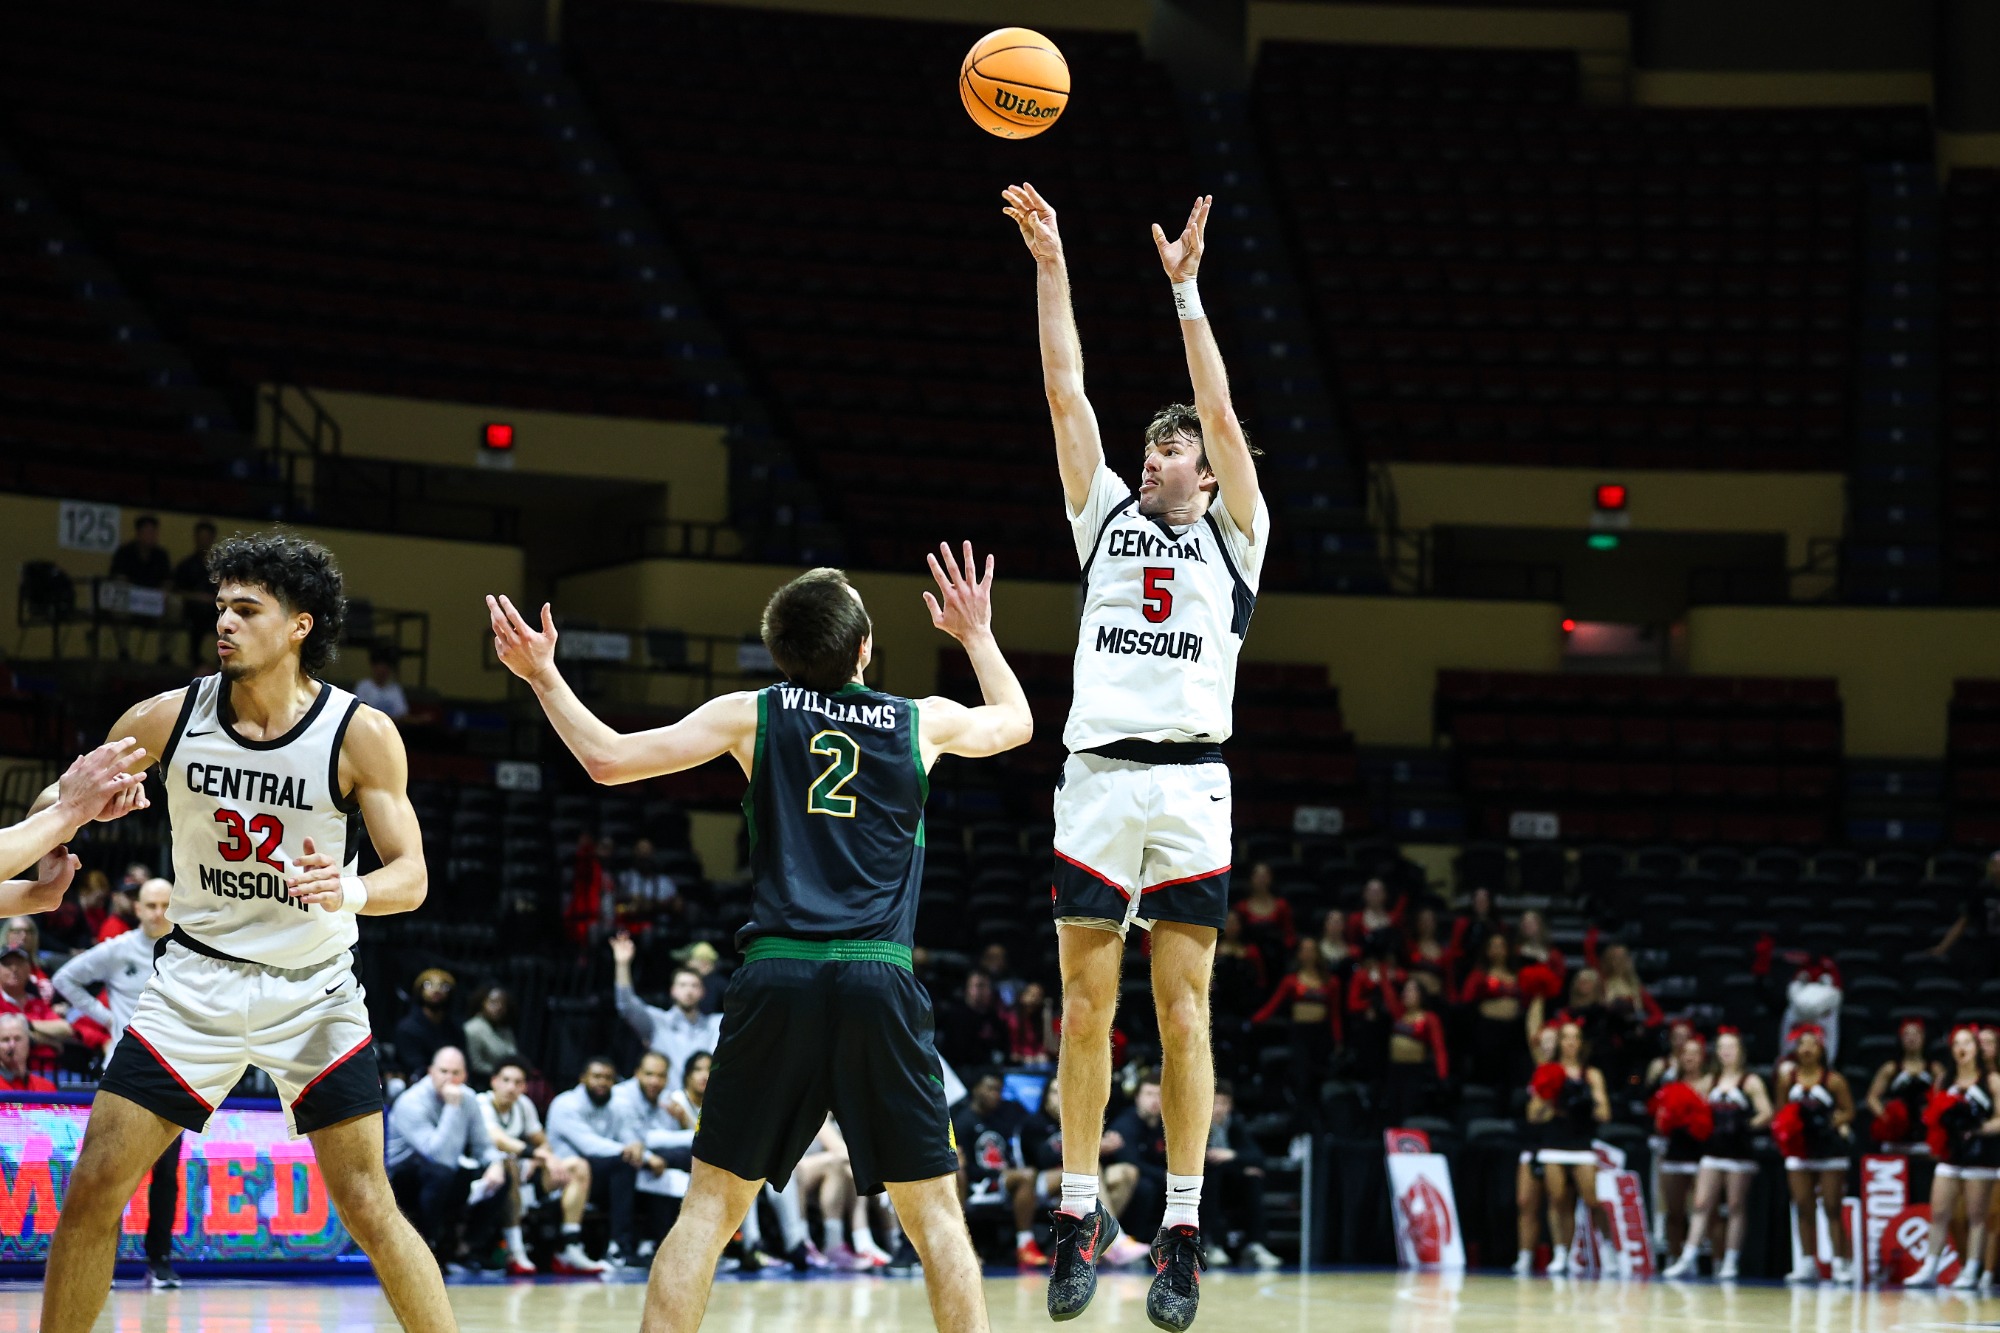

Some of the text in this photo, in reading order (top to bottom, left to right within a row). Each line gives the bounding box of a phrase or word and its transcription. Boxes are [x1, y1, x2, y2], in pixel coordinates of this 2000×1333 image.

[994, 87, 1060, 118] Wilson
[66, 507, 117, 547] 125
[1108, 529, 1207, 565] CENTRAL
[1142, 566, 1175, 623] 5
[1096, 625, 1203, 663] MISSOURI
[780, 687, 896, 729] WILLIAMS
[187, 762, 313, 811] CENTRAL
[807, 729, 860, 818] 2
[213, 807, 284, 873] 32
